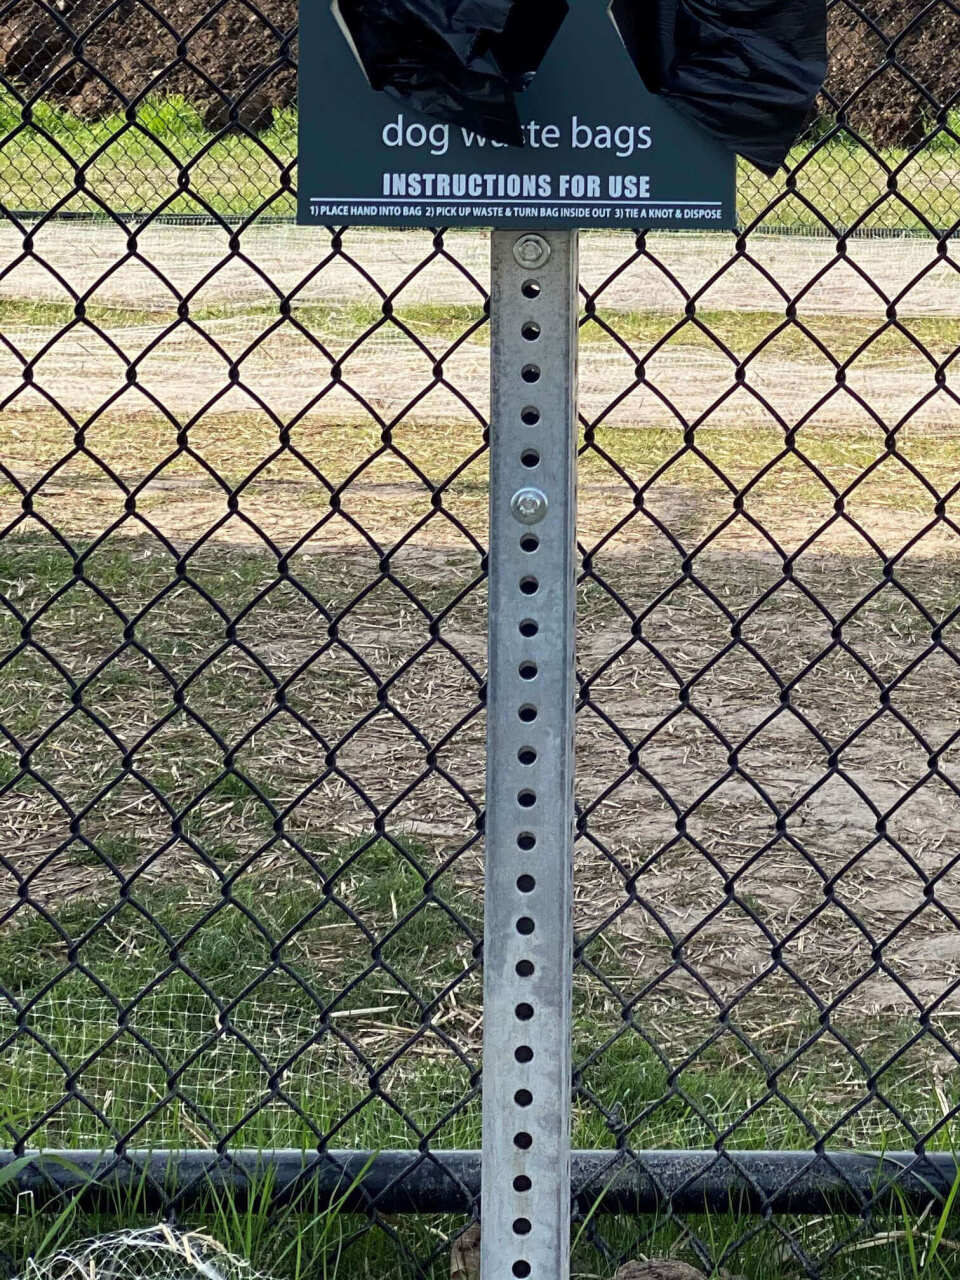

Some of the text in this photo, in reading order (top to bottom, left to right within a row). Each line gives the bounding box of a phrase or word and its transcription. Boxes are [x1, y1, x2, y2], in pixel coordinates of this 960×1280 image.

[382, 114, 652, 157] dog wte bags
[383, 173, 651, 199] INSTRUCTIONS FOR USE
[310, 205, 319, 216] 1)
[320, 205, 349, 216] PLACE
[350, 206, 378, 216] HAND
[379, 206, 401, 216] INTO
[403, 206, 422, 216] BAG
[425, 207, 435, 217] 2)
[436, 206, 457, 216] PICK
[458, 207, 471, 216] UP
[472, 207, 503, 217] WASTE
[513, 207, 538, 217] TURN
[540, 207, 559, 217] BAG
[560, 208, 590, 217] INSIDE
[592, 208, 611, 218] OUT
[614, 208, 624, 219] 3)
[625, 208, 639, 218] TIE
[640, 208, 647, 218] A
[648, 209, 674, 218] KNOT
[684, 209, 722, 219] DISPOSE
